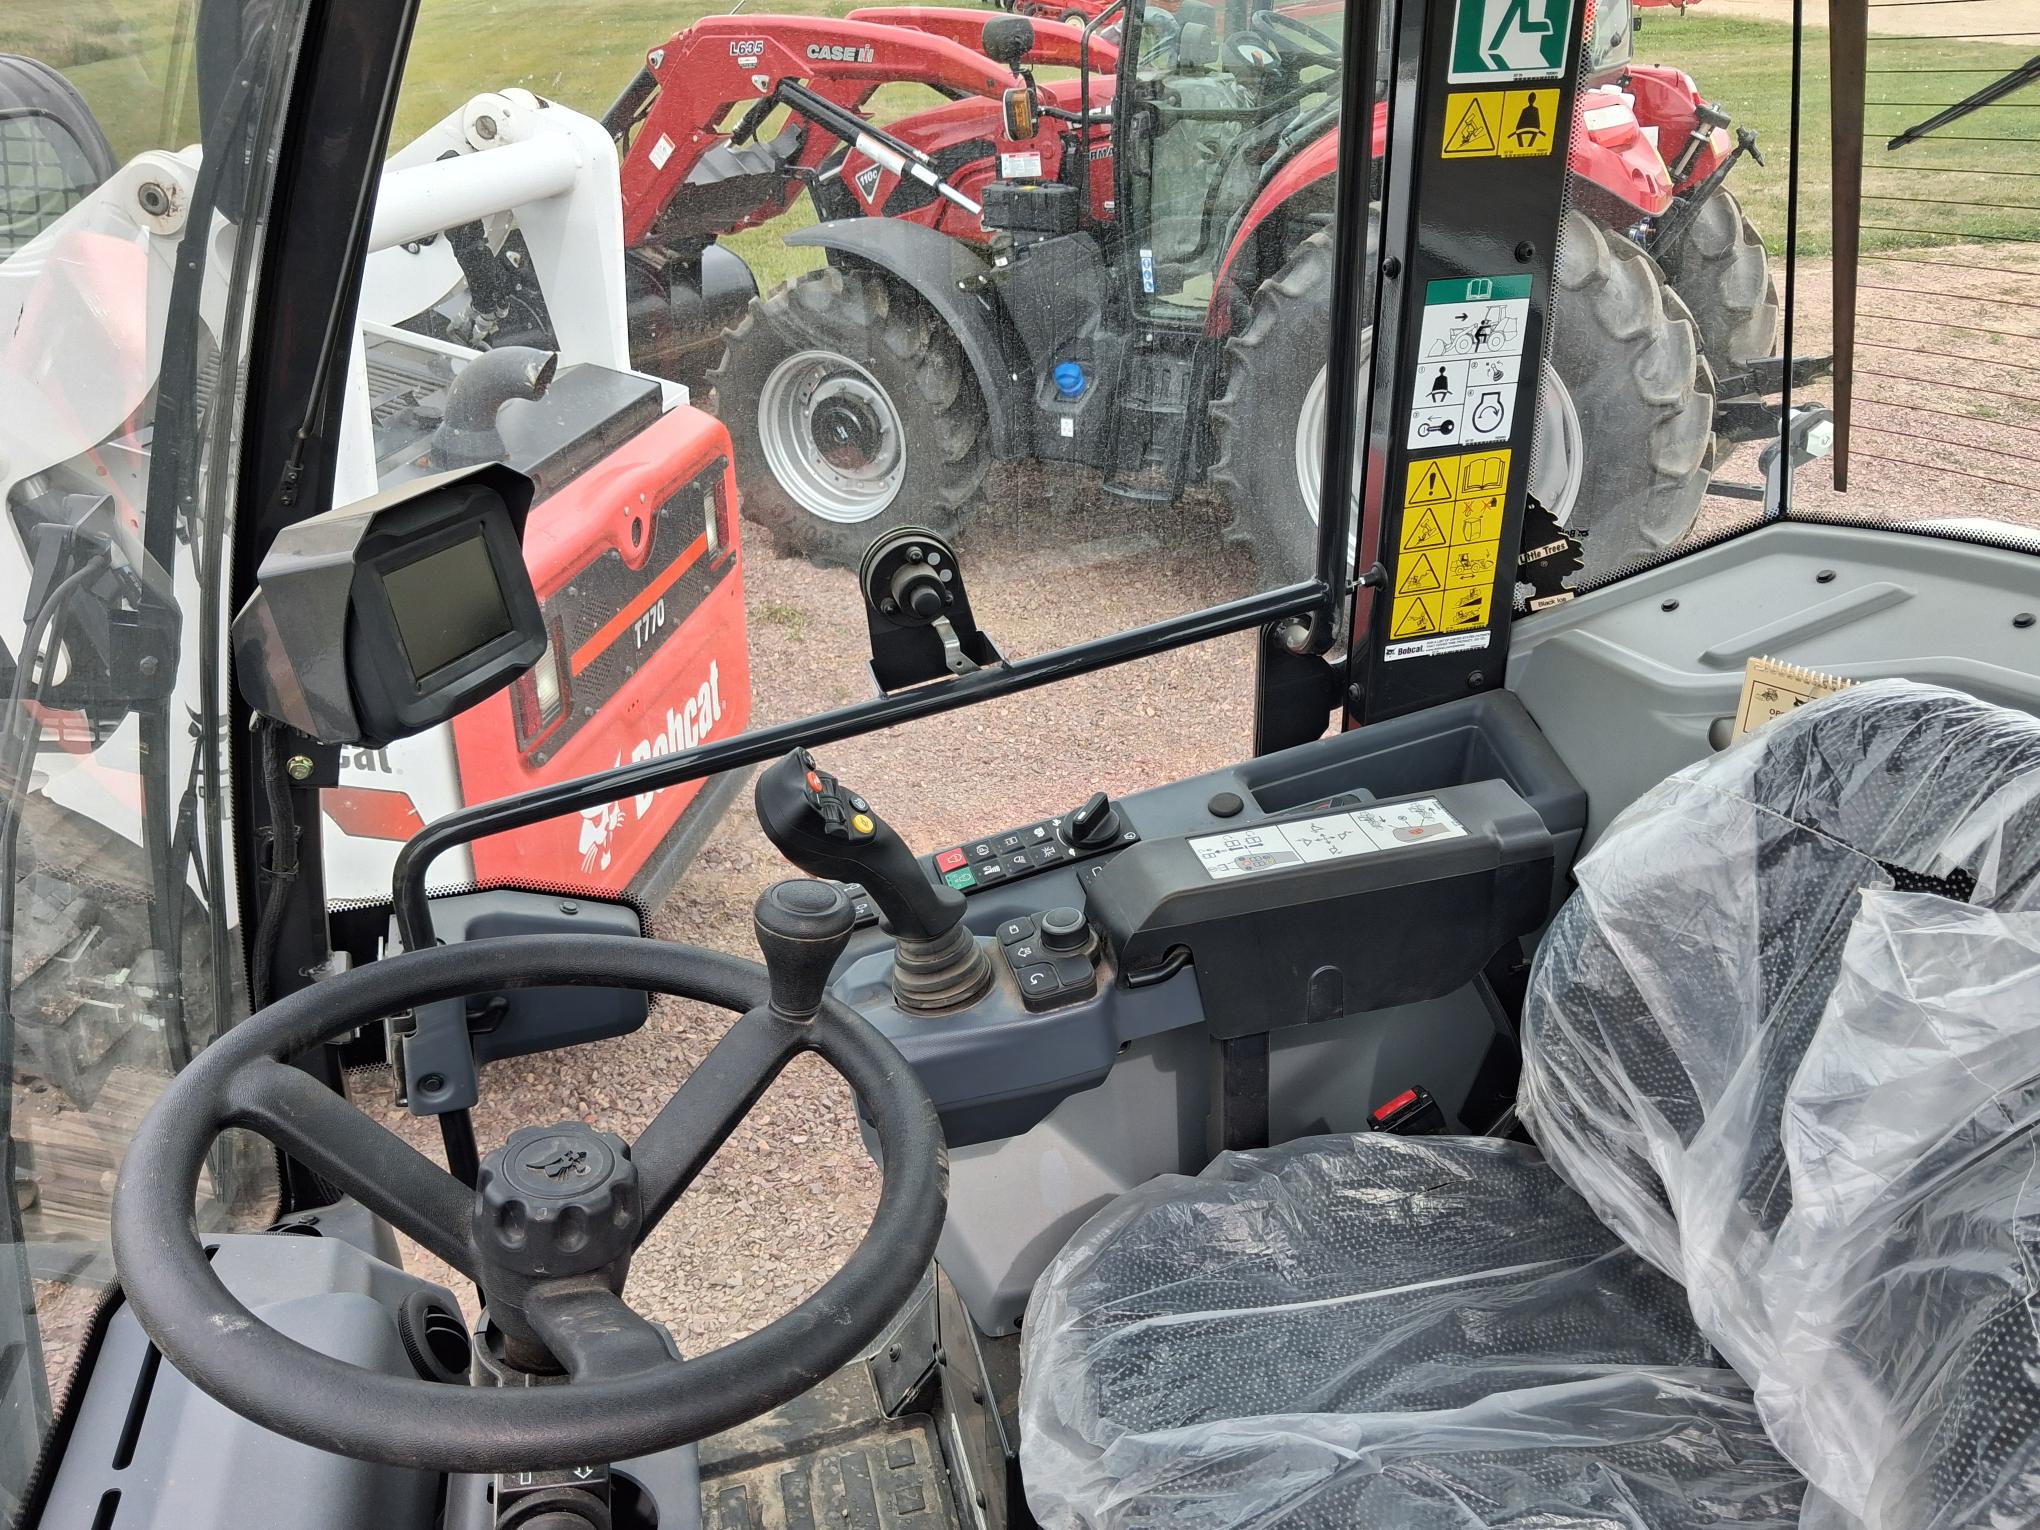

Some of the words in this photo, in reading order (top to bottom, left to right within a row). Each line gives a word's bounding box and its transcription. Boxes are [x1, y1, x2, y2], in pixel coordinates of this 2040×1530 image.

[730, 41, 764, 56] L635
[806, 44, 855, 61] CASE
[1542, 542, 1566, 556] Trees
[634, 599, 665, 650] T770
[1398, 645, 1424, 656] Bobcat
